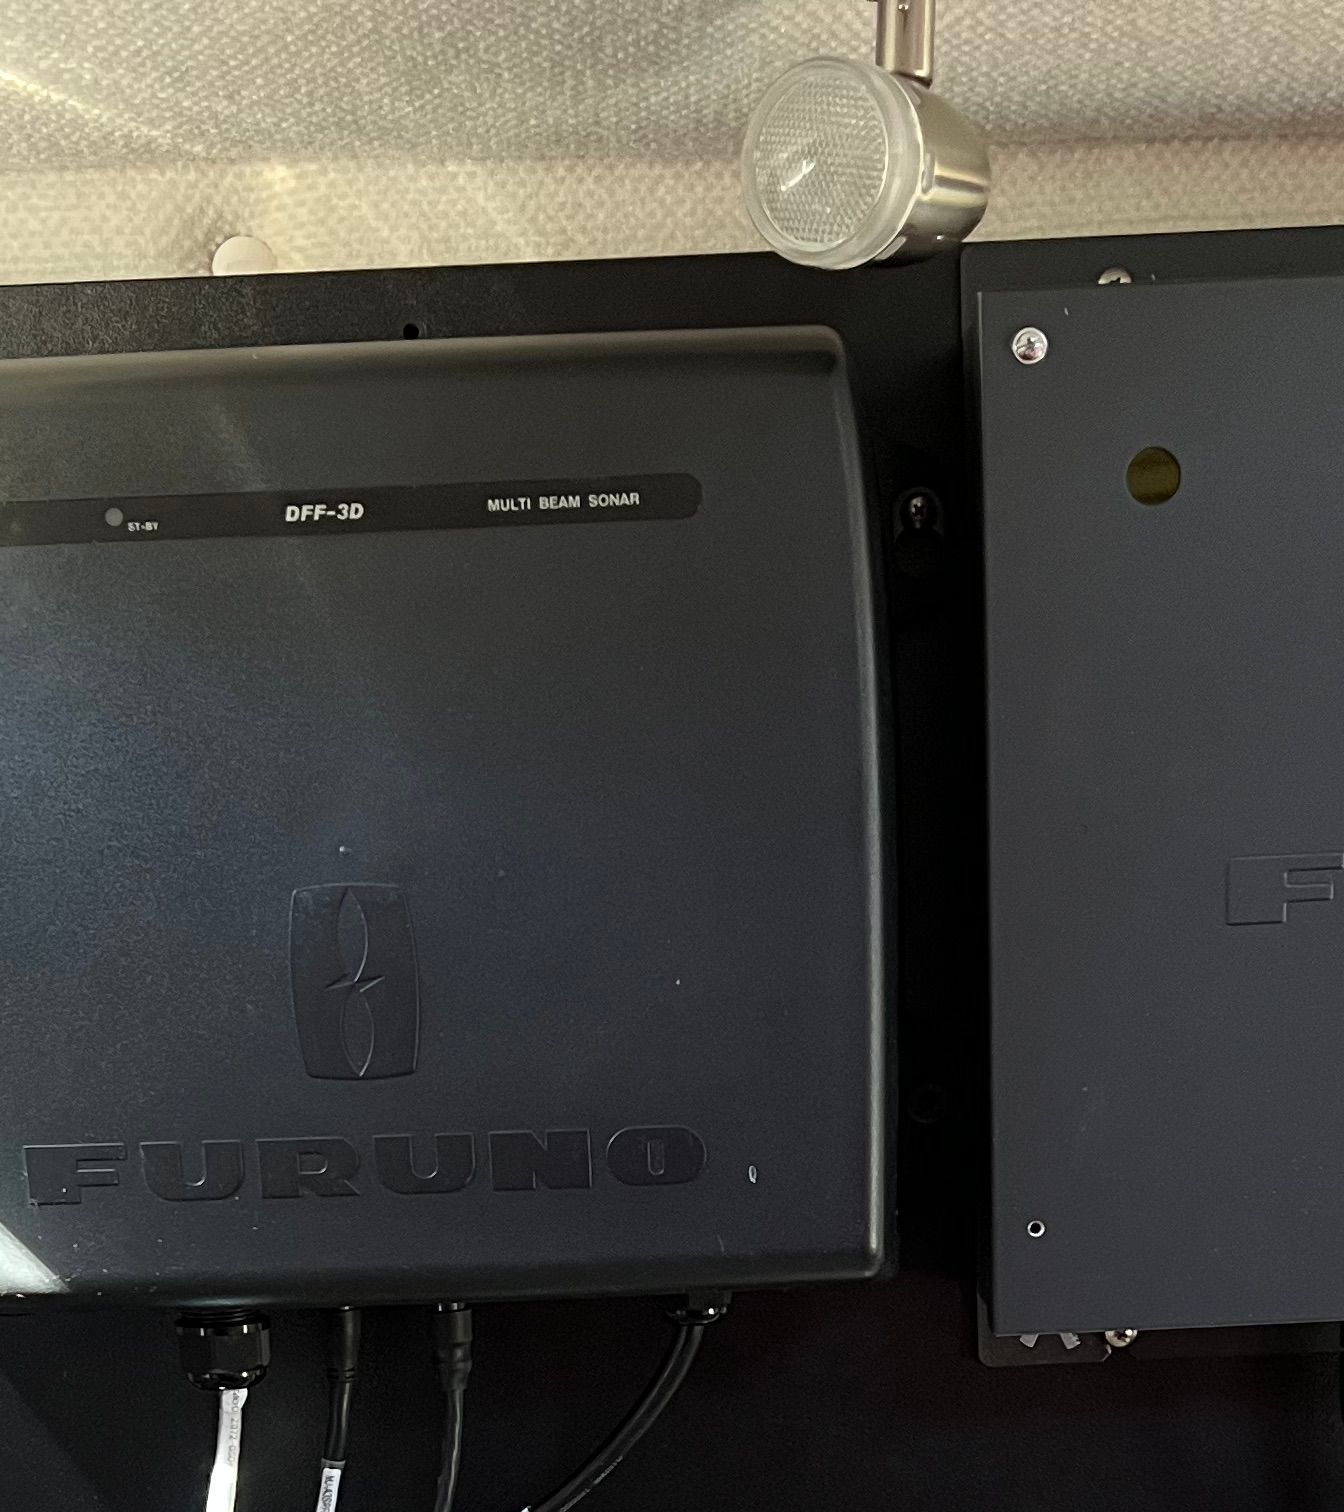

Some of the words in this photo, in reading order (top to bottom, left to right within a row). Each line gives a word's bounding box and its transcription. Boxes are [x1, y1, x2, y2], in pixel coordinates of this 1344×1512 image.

[285, 501, 364, 522] DFF-3D
[488, 496, 532, 512] MULTI
[539, 495, 581, 510] BEAM
[588, 492, 640, 509] SONAR
[22, 1125, 708, 1206] FURUNO
